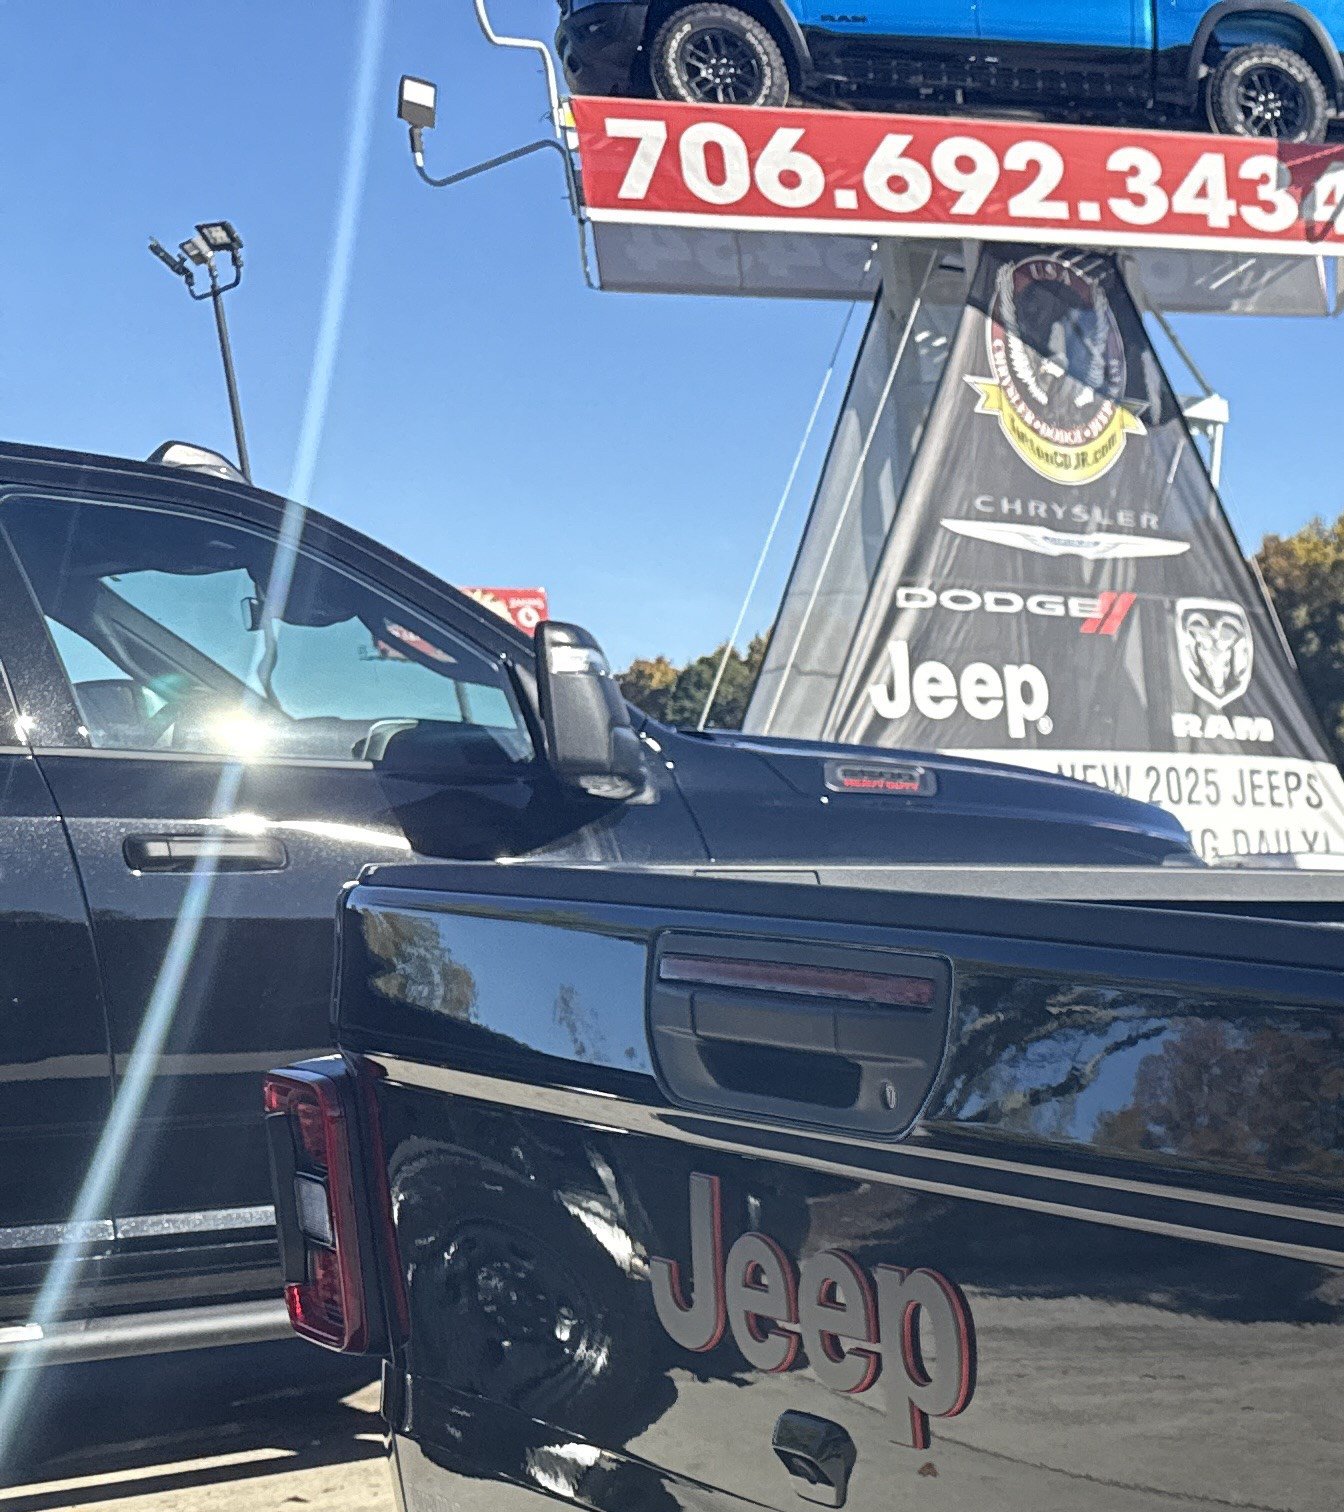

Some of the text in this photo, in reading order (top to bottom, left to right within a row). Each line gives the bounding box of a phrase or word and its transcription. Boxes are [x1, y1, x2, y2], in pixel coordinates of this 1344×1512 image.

[973, 494, 1160, 529] CHRYSLER
[895, 586, 1100, 618] DODGE
[868, 640, 1050, 739] Jeep
[1171, 712, 1274, 742] RAM
[1145, 765, 1222, 806] 2025
[1232, 768, 1324, 810] JEEPS
[650, 1171, 976, 1449] Jeep
